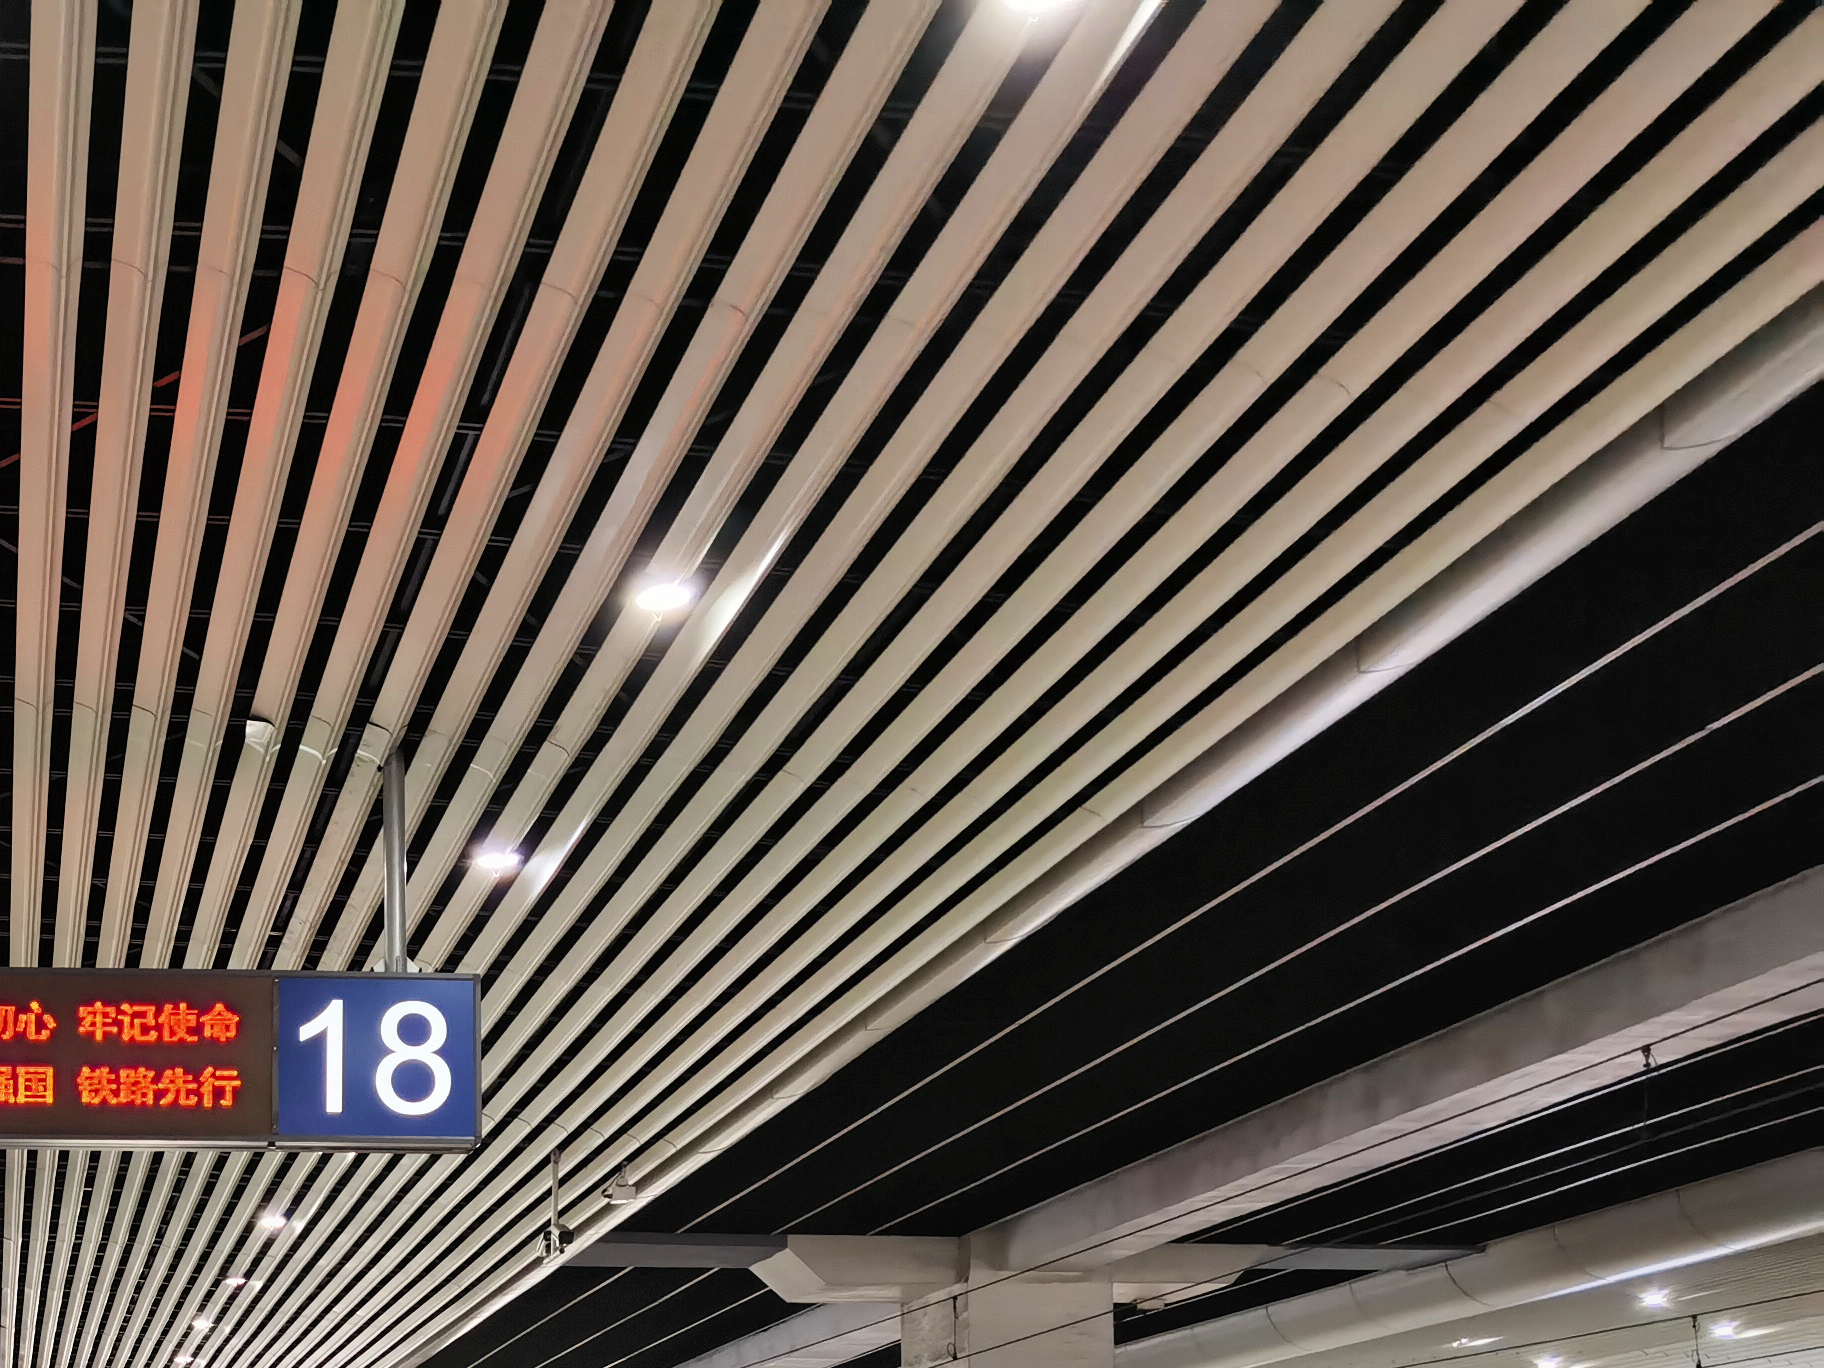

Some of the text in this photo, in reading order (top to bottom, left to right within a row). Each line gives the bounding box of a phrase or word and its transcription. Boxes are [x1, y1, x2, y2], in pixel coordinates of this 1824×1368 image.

[78, 1001, 240, 1041] 牢记使命
[299, 999, 452, 1116] 18
[77, 1066, 242, 1107] 铁路先行
